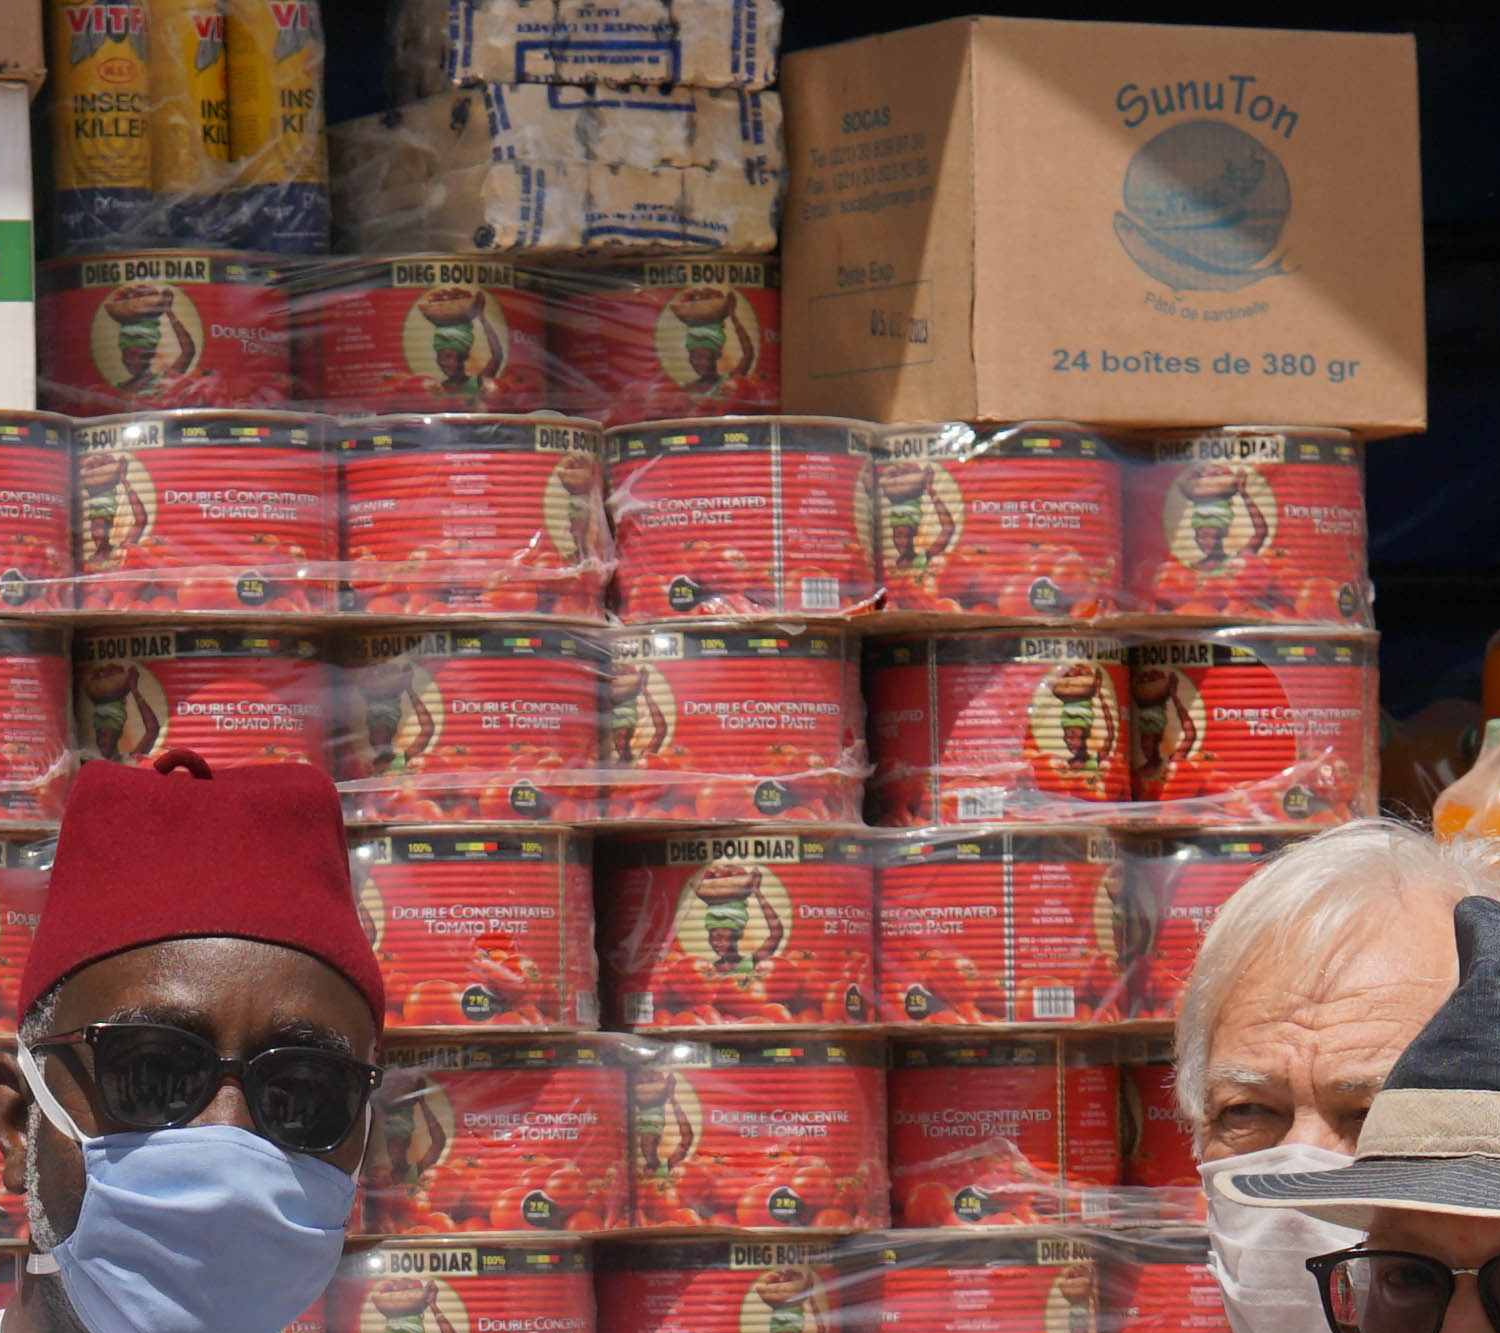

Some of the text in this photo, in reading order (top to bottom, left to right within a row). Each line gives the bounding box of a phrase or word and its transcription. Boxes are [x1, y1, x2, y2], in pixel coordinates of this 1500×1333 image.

[1116, 75, 1299, 139] SunuTon
[86, 260, 206, 284] DIEG BOU DIAR
[1180, 301, 1198, 320] de
[1203, 299, 1270, 321] sardinelle
[1052, 349, 1360, 382] 24 boîtes de 380 gr
[670, 837, 795, 862] DIEG BOU DIAR
[392, 905, 555, 920] DOUBLE CONCENTRATED
[425, 919, 529, 935] TOMATO PASTE
[711, 1110, 767, 1124] DOUBLE
[945, 1109, 1051, 1123] CONCENTRATED
[740, 1124, 828, 1138] DE TOMATES
[922, 1123, 976, 1137] TOMATO
